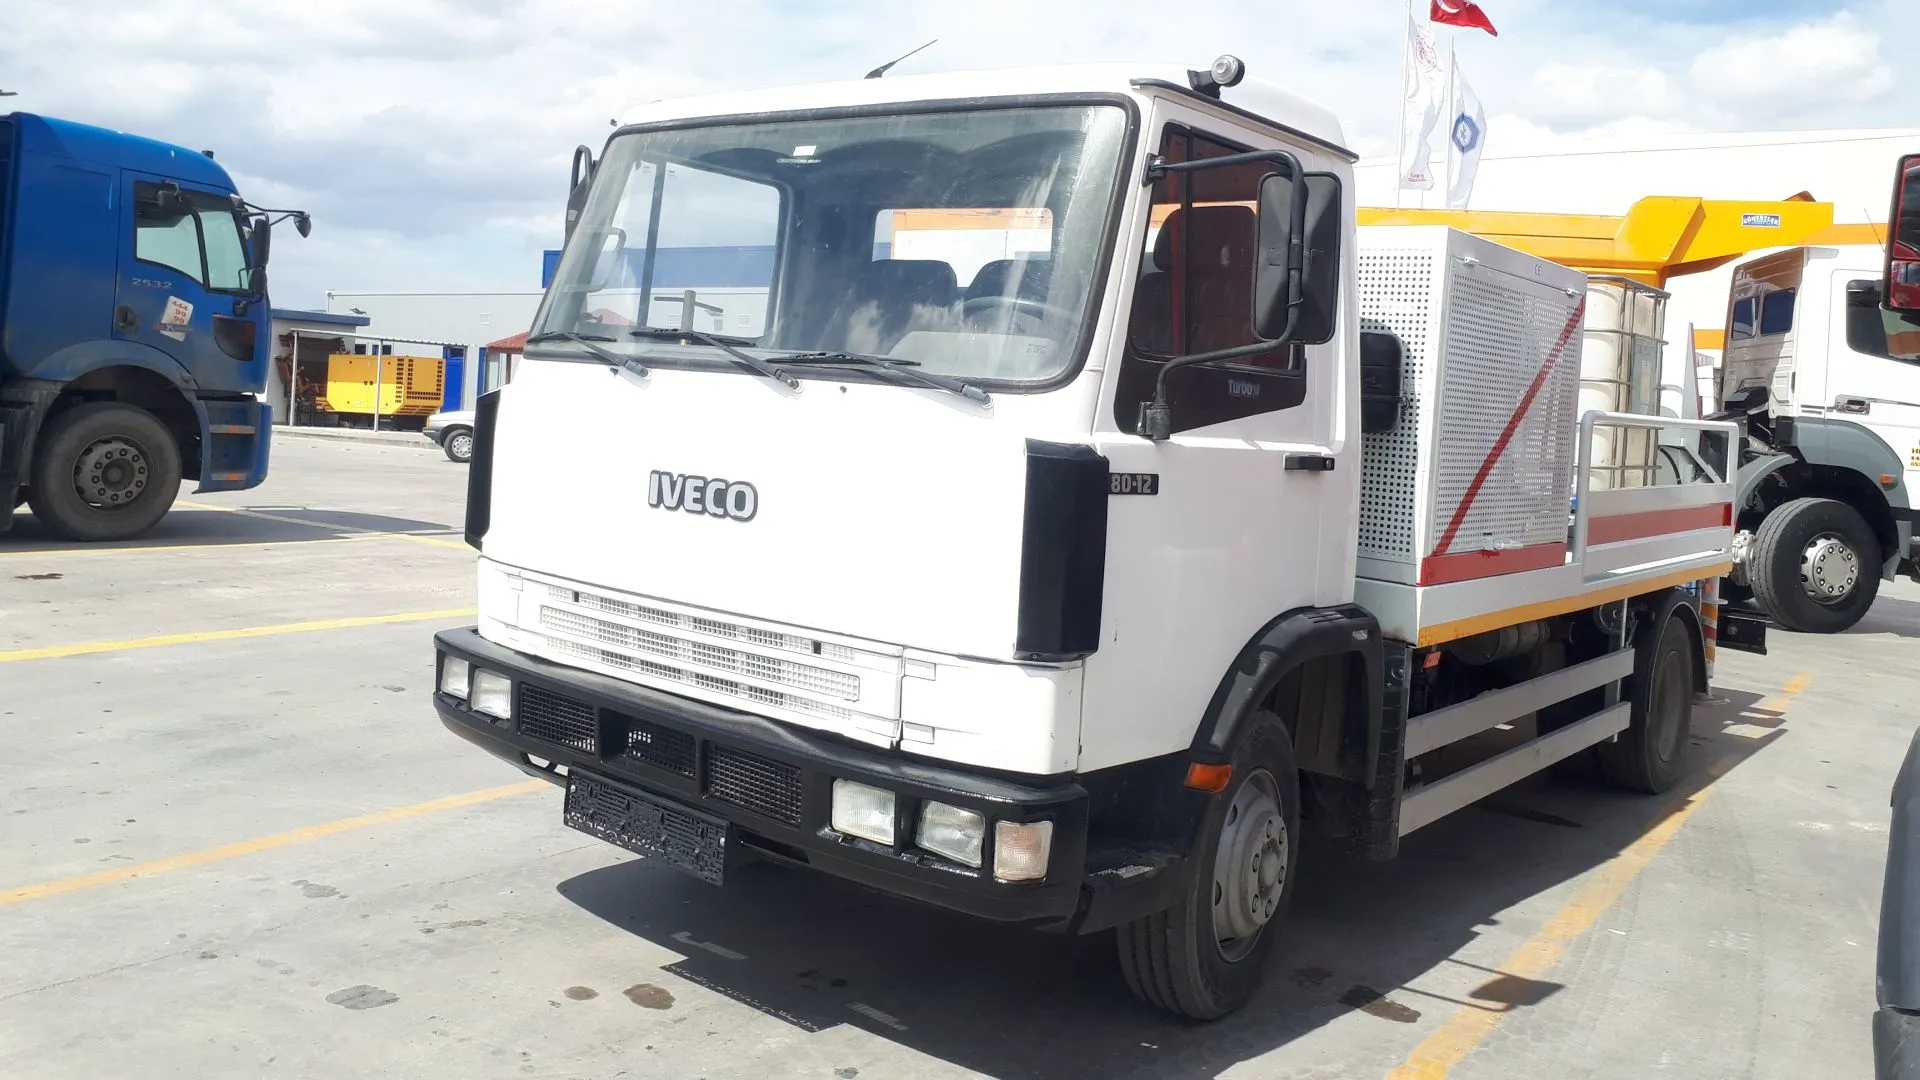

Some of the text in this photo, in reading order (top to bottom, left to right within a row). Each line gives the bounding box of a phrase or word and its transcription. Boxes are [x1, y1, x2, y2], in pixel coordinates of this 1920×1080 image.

[132, 277, 172, 289] 2532
[1111, 474, 1152, 494] 80-12
[648, 469, 759, 522] IVECO
